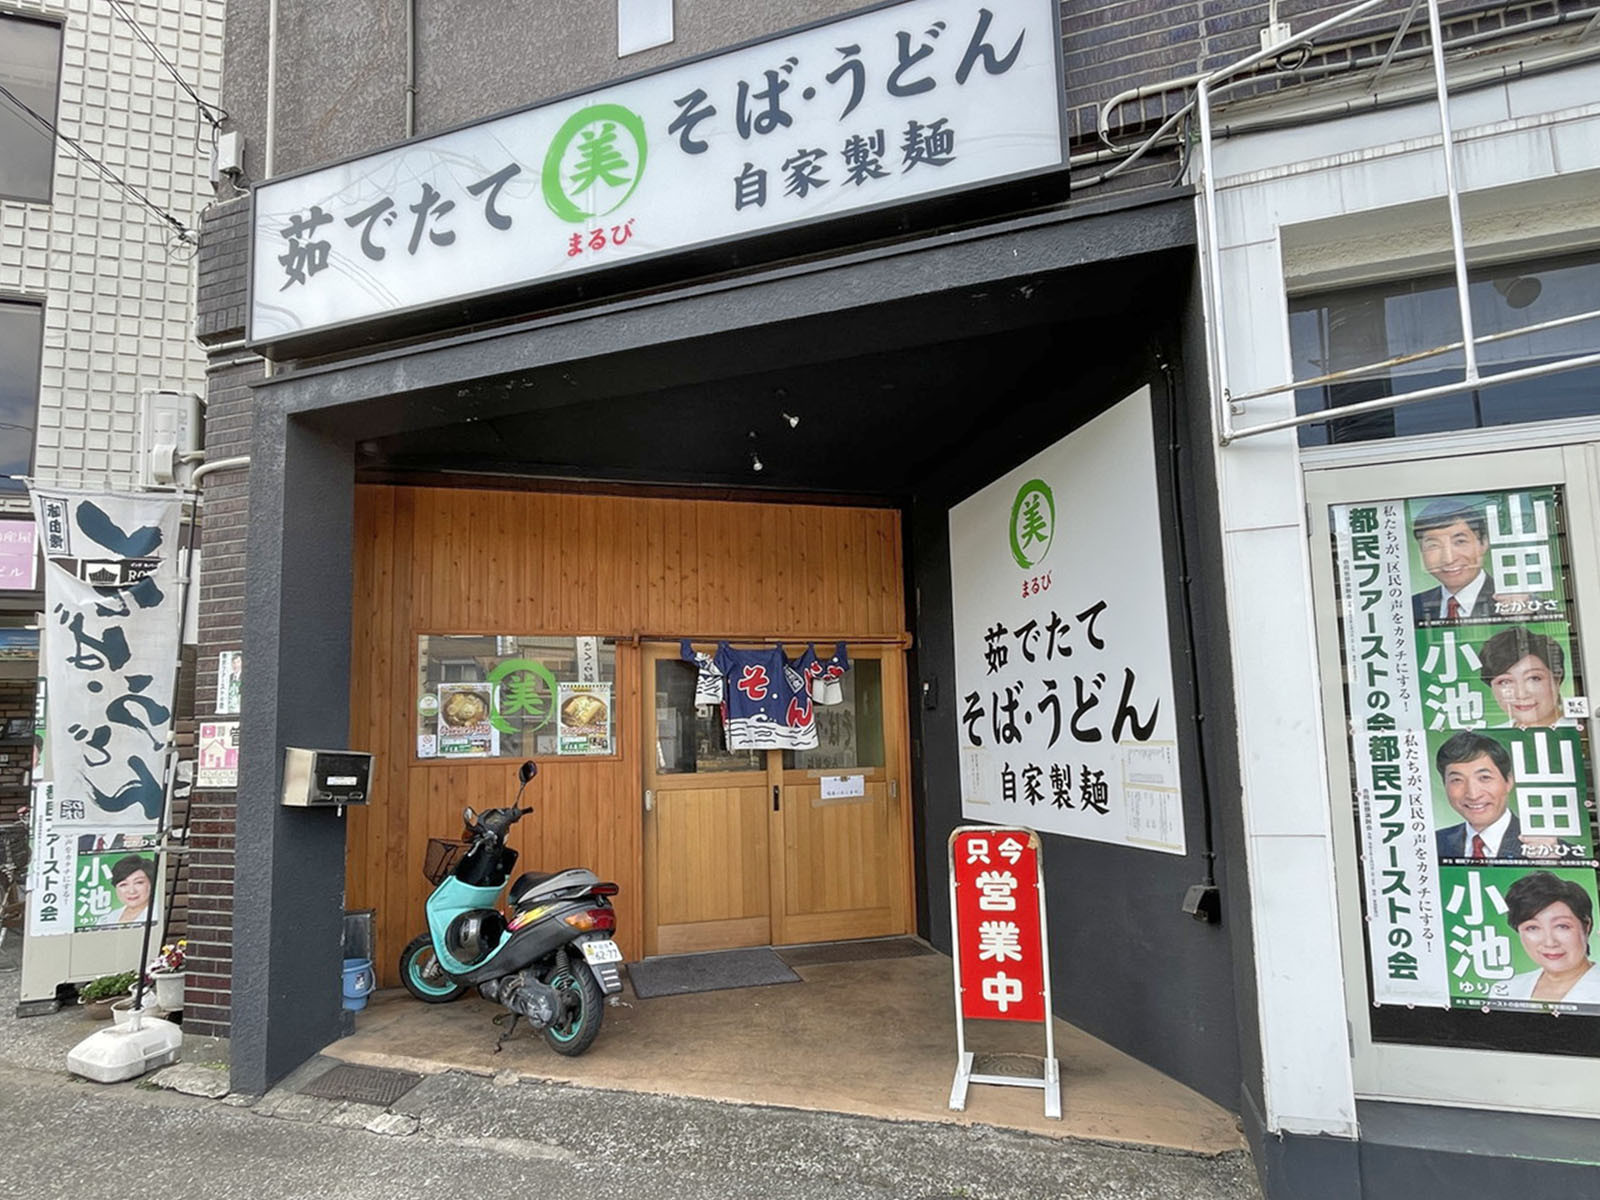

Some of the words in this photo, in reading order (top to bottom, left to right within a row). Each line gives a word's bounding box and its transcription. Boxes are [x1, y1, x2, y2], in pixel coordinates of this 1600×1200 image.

[668, 7, 1026, 155] そば・うどん
[568, 122, 633, 196] 美
[733, 117, 957, 212] 自家製麺
[278, 162, 521, 292] 茹でたて
[566, 217, 637, 257] まるび
[1020, 493, 1049, 550] 美
[1486, 493, 1554, 595] 山田
[1021, 570, 1052, 599] まるび
[1348, 506, 1397, 731] 都民ファーストの会
[1494, 599, 1559, 614] たかひさ
[984, 600, 1108, 676] 茹でたて
[502, 672, 545, 715] 美
[737, 664, 770, 700] そ
[962, 667, 1160, 750] そば・うどん
[1421, 631, 1487, 730] 小池
[1001, 761, 1110, 815] 自家製麺
[1510, 731, 1582, 837] 山田
[77, 857, 114, 916] 小池
[966, 837, 1024, 865] 只今
[1368, 735, 1419, 981] 都民ファーストの会
[1520, 844, 1587, 857] たかひさ
[975, 870, 1024, 1013] 営業中
[1446, 871, 1515, 980] 小池
